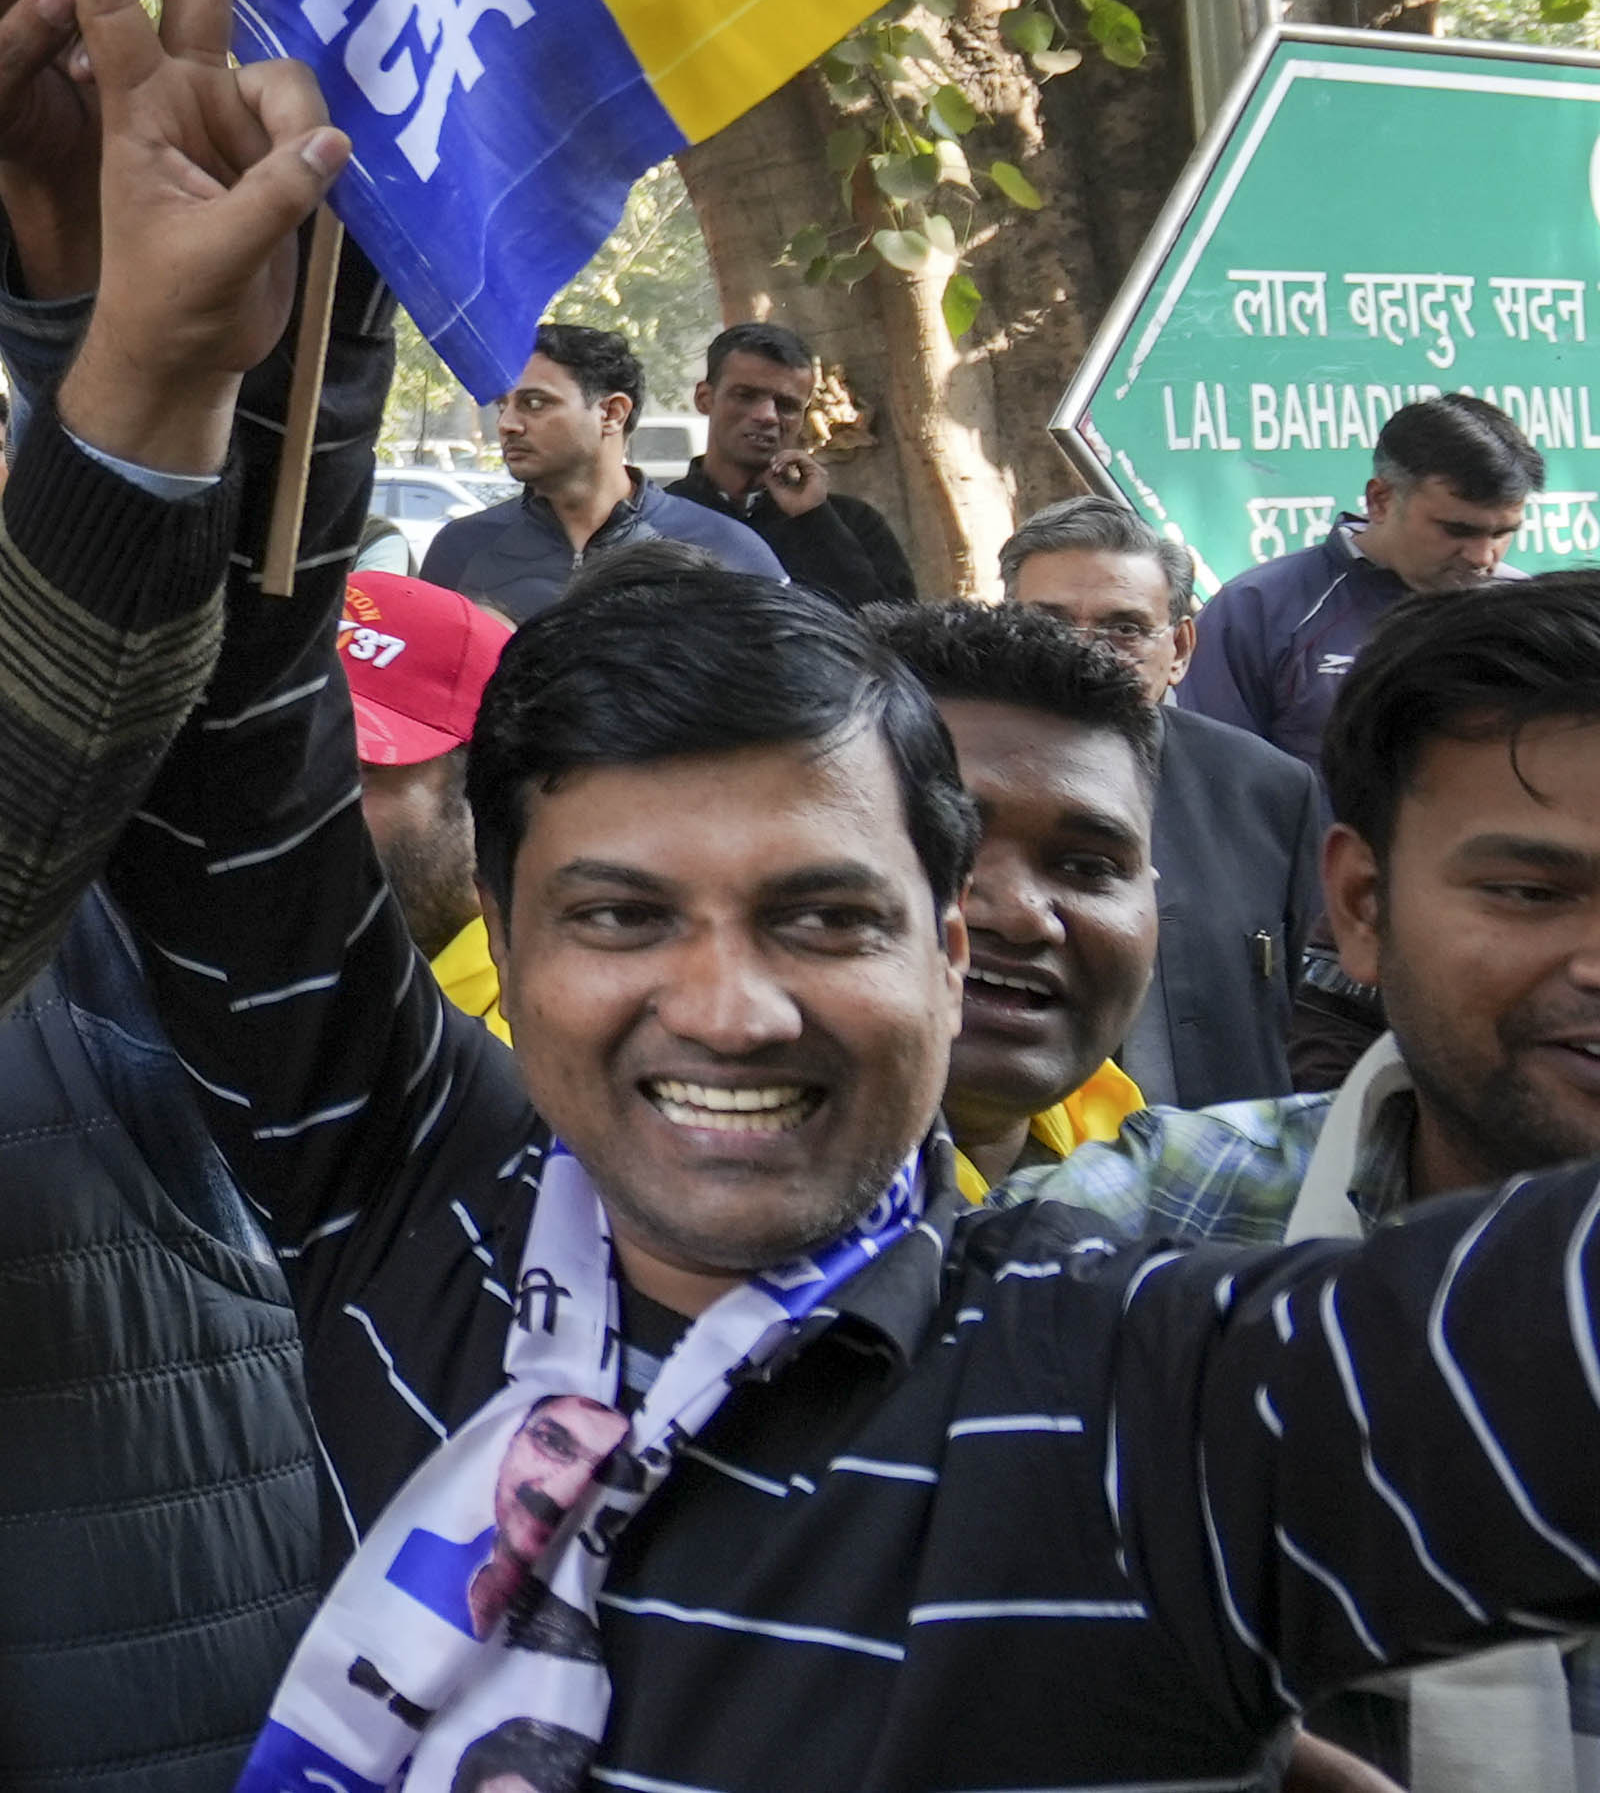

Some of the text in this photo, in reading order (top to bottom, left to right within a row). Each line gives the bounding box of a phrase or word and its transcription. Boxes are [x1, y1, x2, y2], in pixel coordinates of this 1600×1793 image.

[1227, 269, 1586, 369] लाल बहादुर सदन
[1163, 381, 1241, 450] LAL
